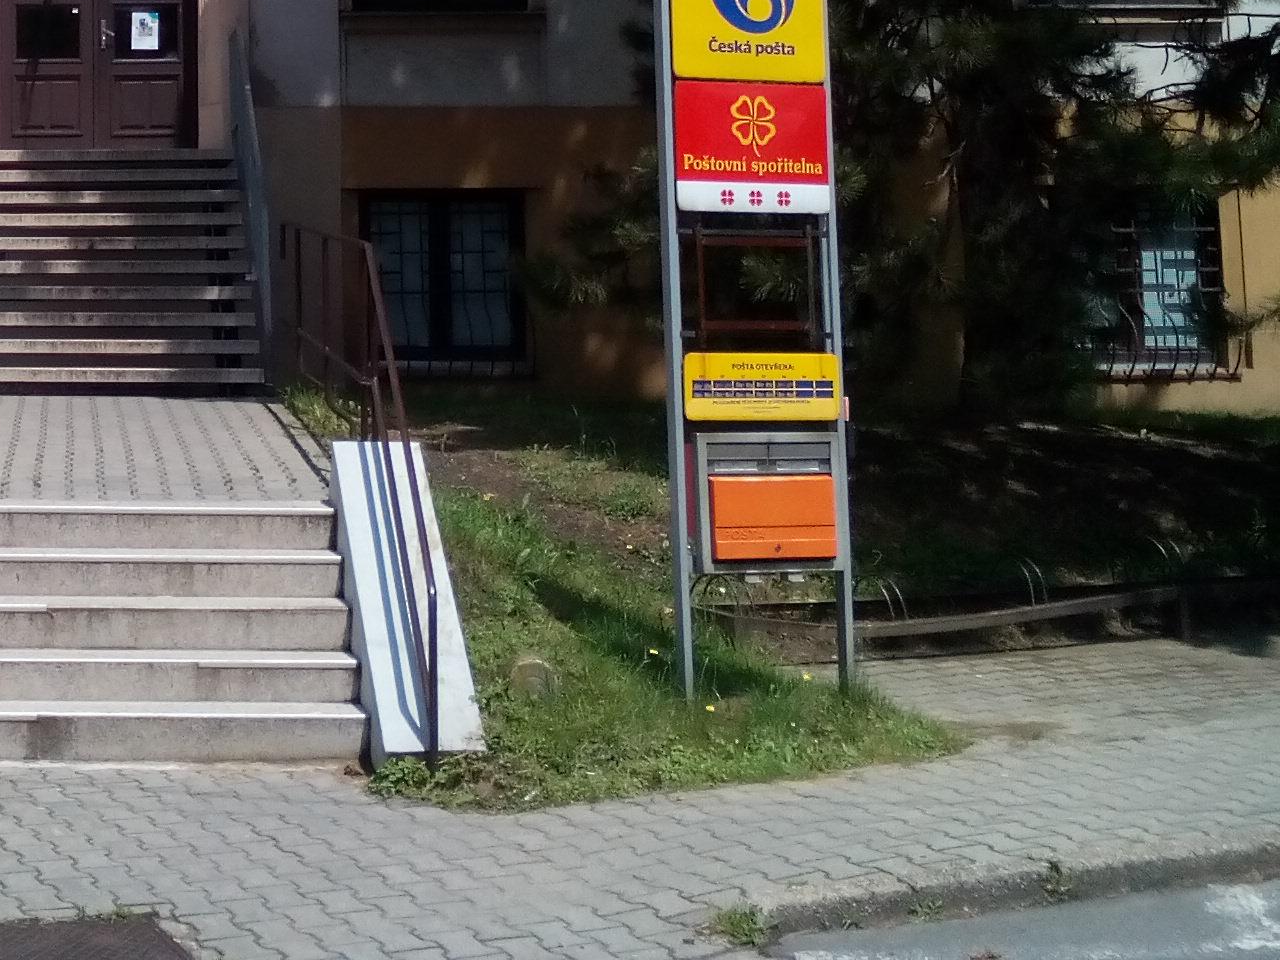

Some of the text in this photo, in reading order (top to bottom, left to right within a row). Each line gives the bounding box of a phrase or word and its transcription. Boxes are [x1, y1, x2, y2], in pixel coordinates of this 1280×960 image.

[708, 36, 795, 57] Česká pošta
[683, 153, 823, 176] Poštovní spořitelna
